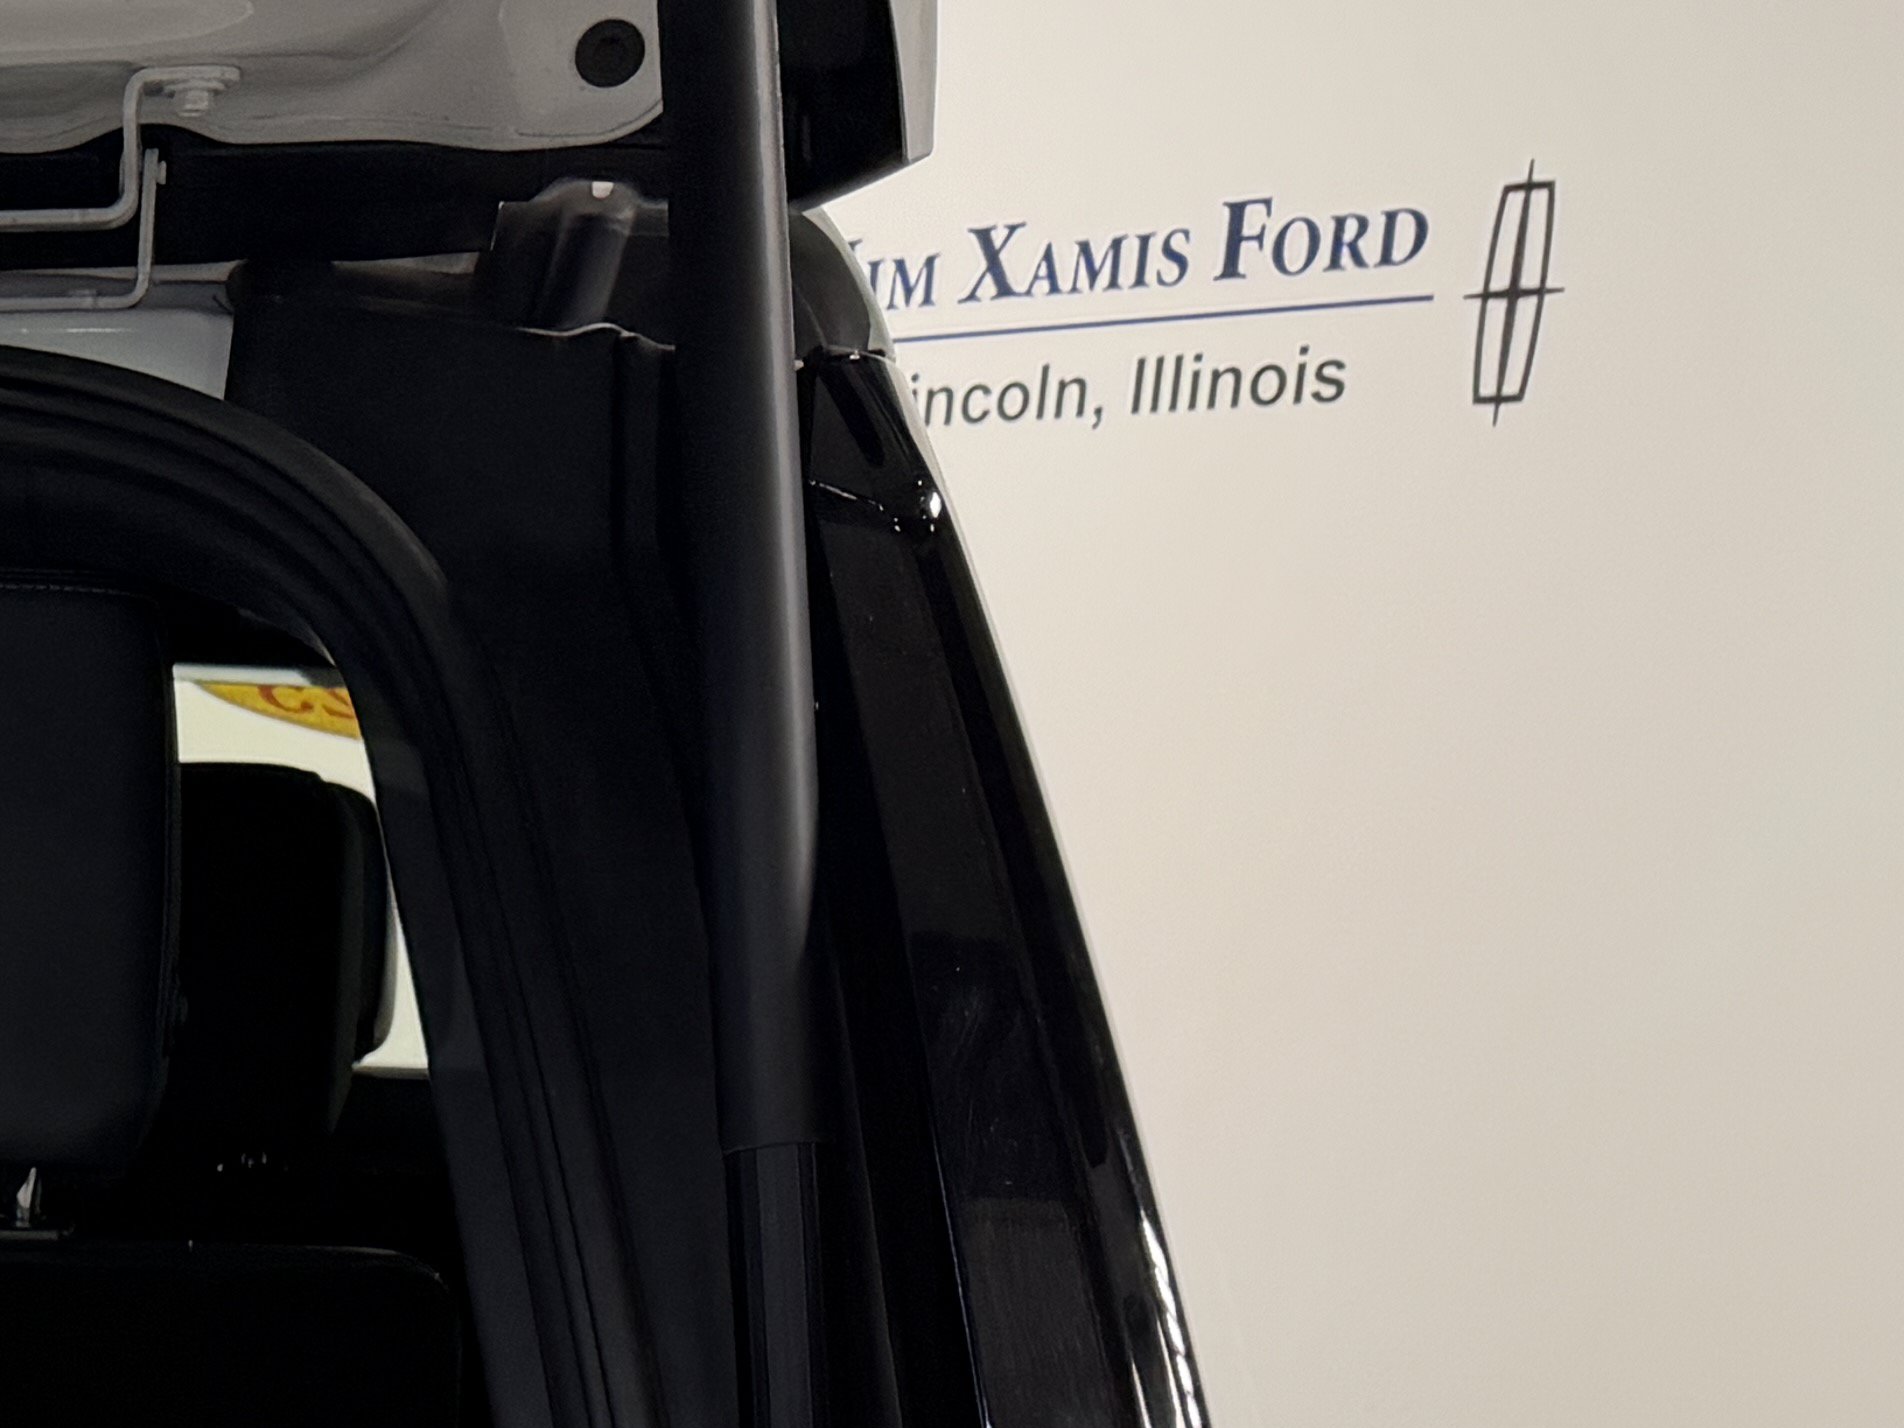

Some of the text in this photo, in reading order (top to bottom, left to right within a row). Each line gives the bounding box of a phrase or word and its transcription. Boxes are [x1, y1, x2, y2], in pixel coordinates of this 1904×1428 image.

[848, 197, 1430, 310] IM XAMIS FORD
[910, 345, 1348, 430] ncoln, Illinois
